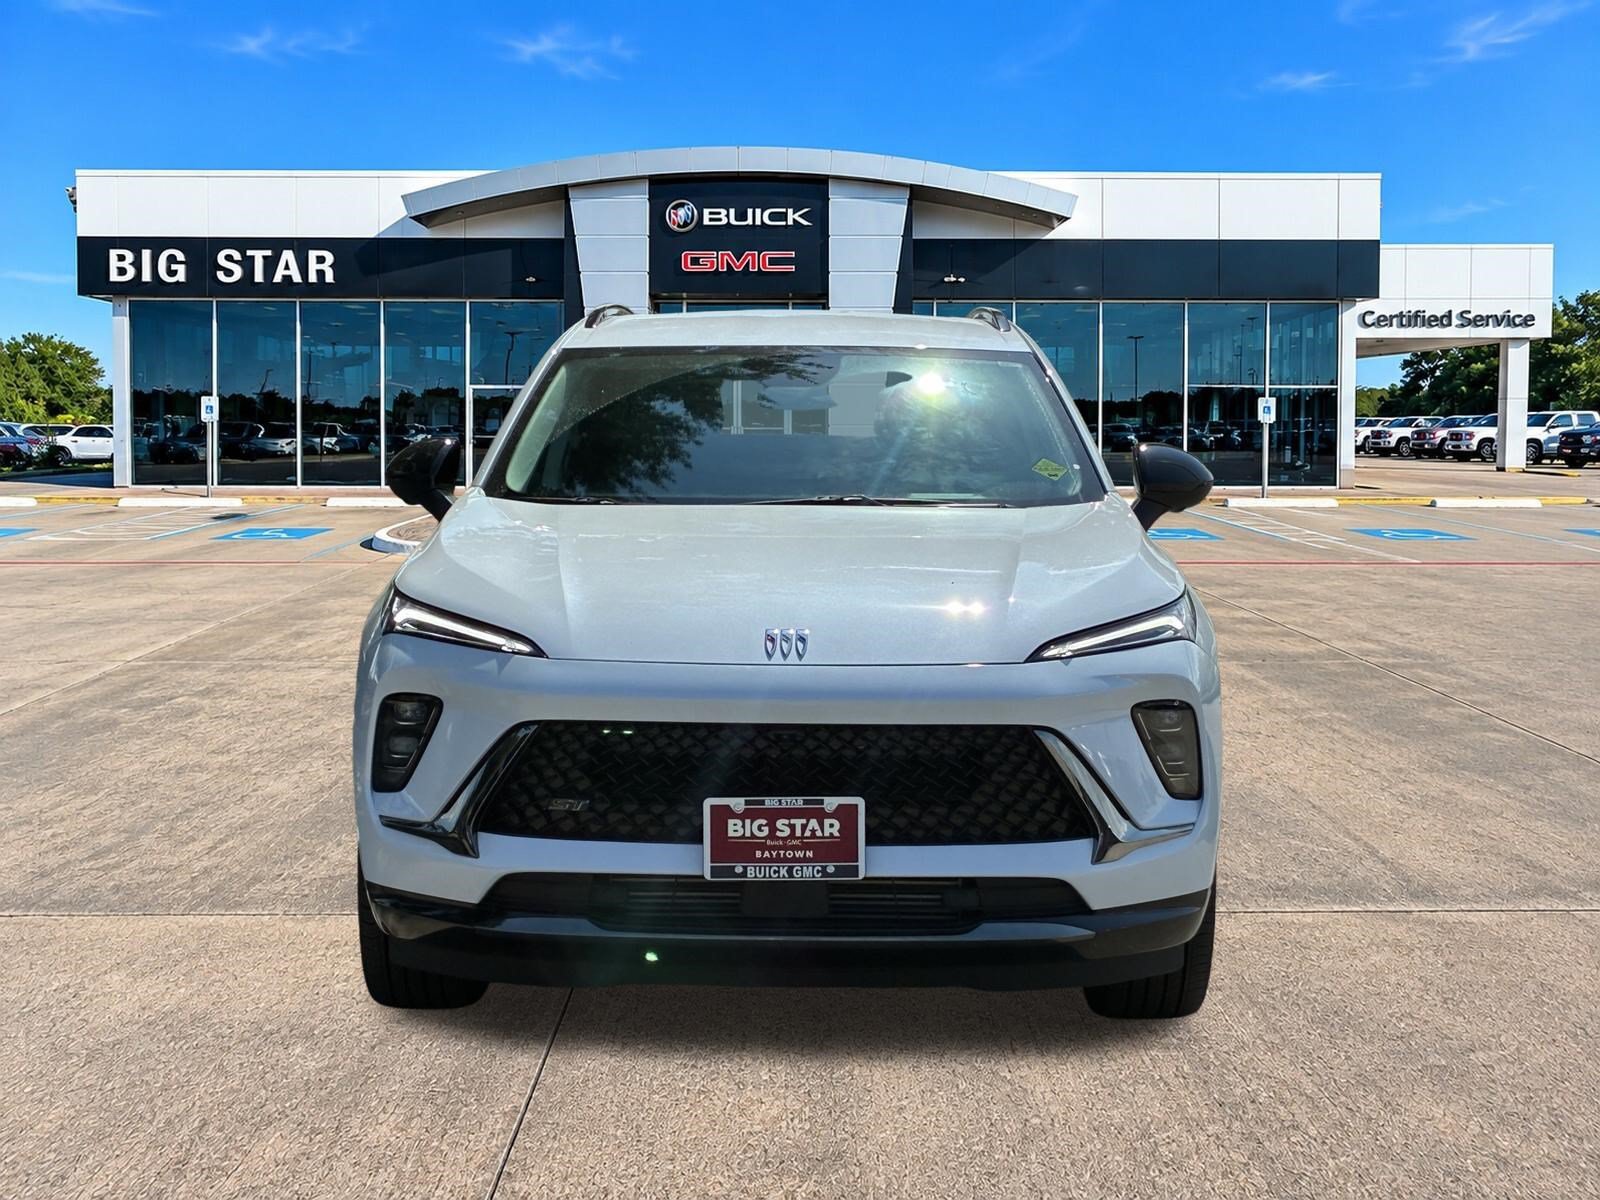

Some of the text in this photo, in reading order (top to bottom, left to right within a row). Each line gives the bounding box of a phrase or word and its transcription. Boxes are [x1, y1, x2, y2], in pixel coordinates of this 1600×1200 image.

[702, 207, 813, 226] BUICK
[108, 248, 336, 283] BIG STAR
[681, 250, 796, 272] GMC
[1359, 309, 1536, 328] Certified Service
[727, 818, 841, 838] BIG STAR
[755, 850, 814, 859] BAYTOWN
[746, 866, 822, 878] BUICK GMC
